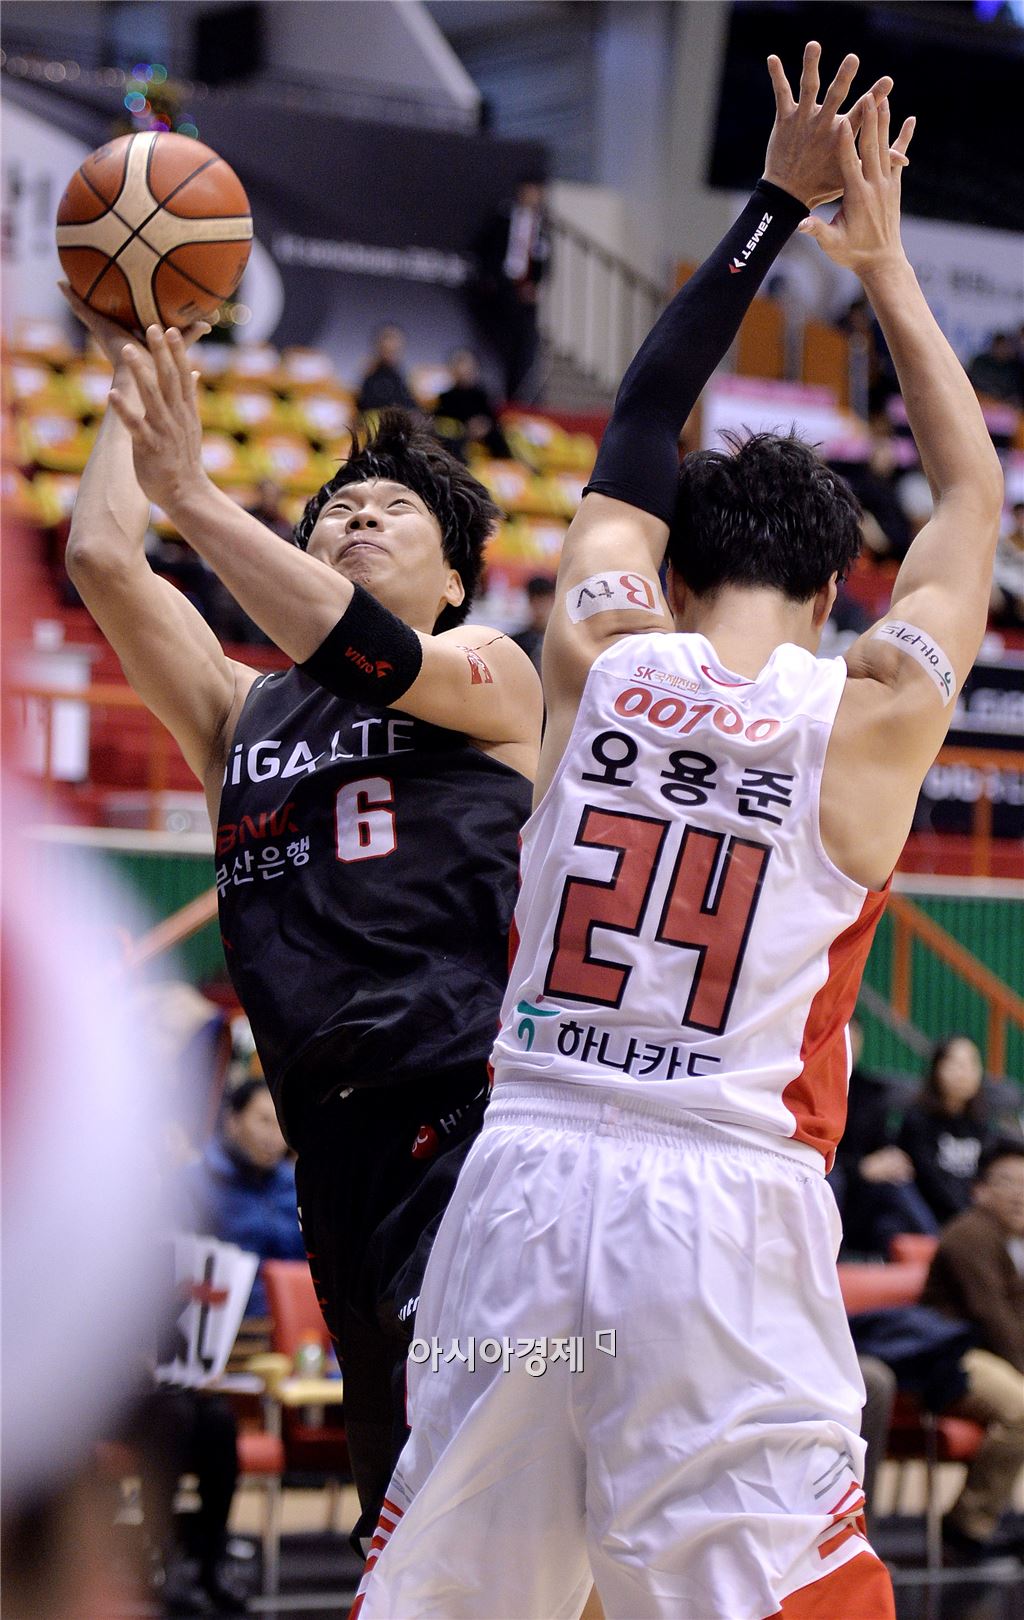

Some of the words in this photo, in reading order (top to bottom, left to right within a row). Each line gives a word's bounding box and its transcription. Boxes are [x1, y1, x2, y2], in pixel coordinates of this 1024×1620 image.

[620, 574, 656, 609] B
[614, 687, 782, 742] 00700
[223, 740, 326, 787] iGA
[329, 718, 416, 762] LTE
[335, 776, 397, 863] 6
[216, 835, 310, 898] 부산은행
[543, 804, 773, 1036] 24
